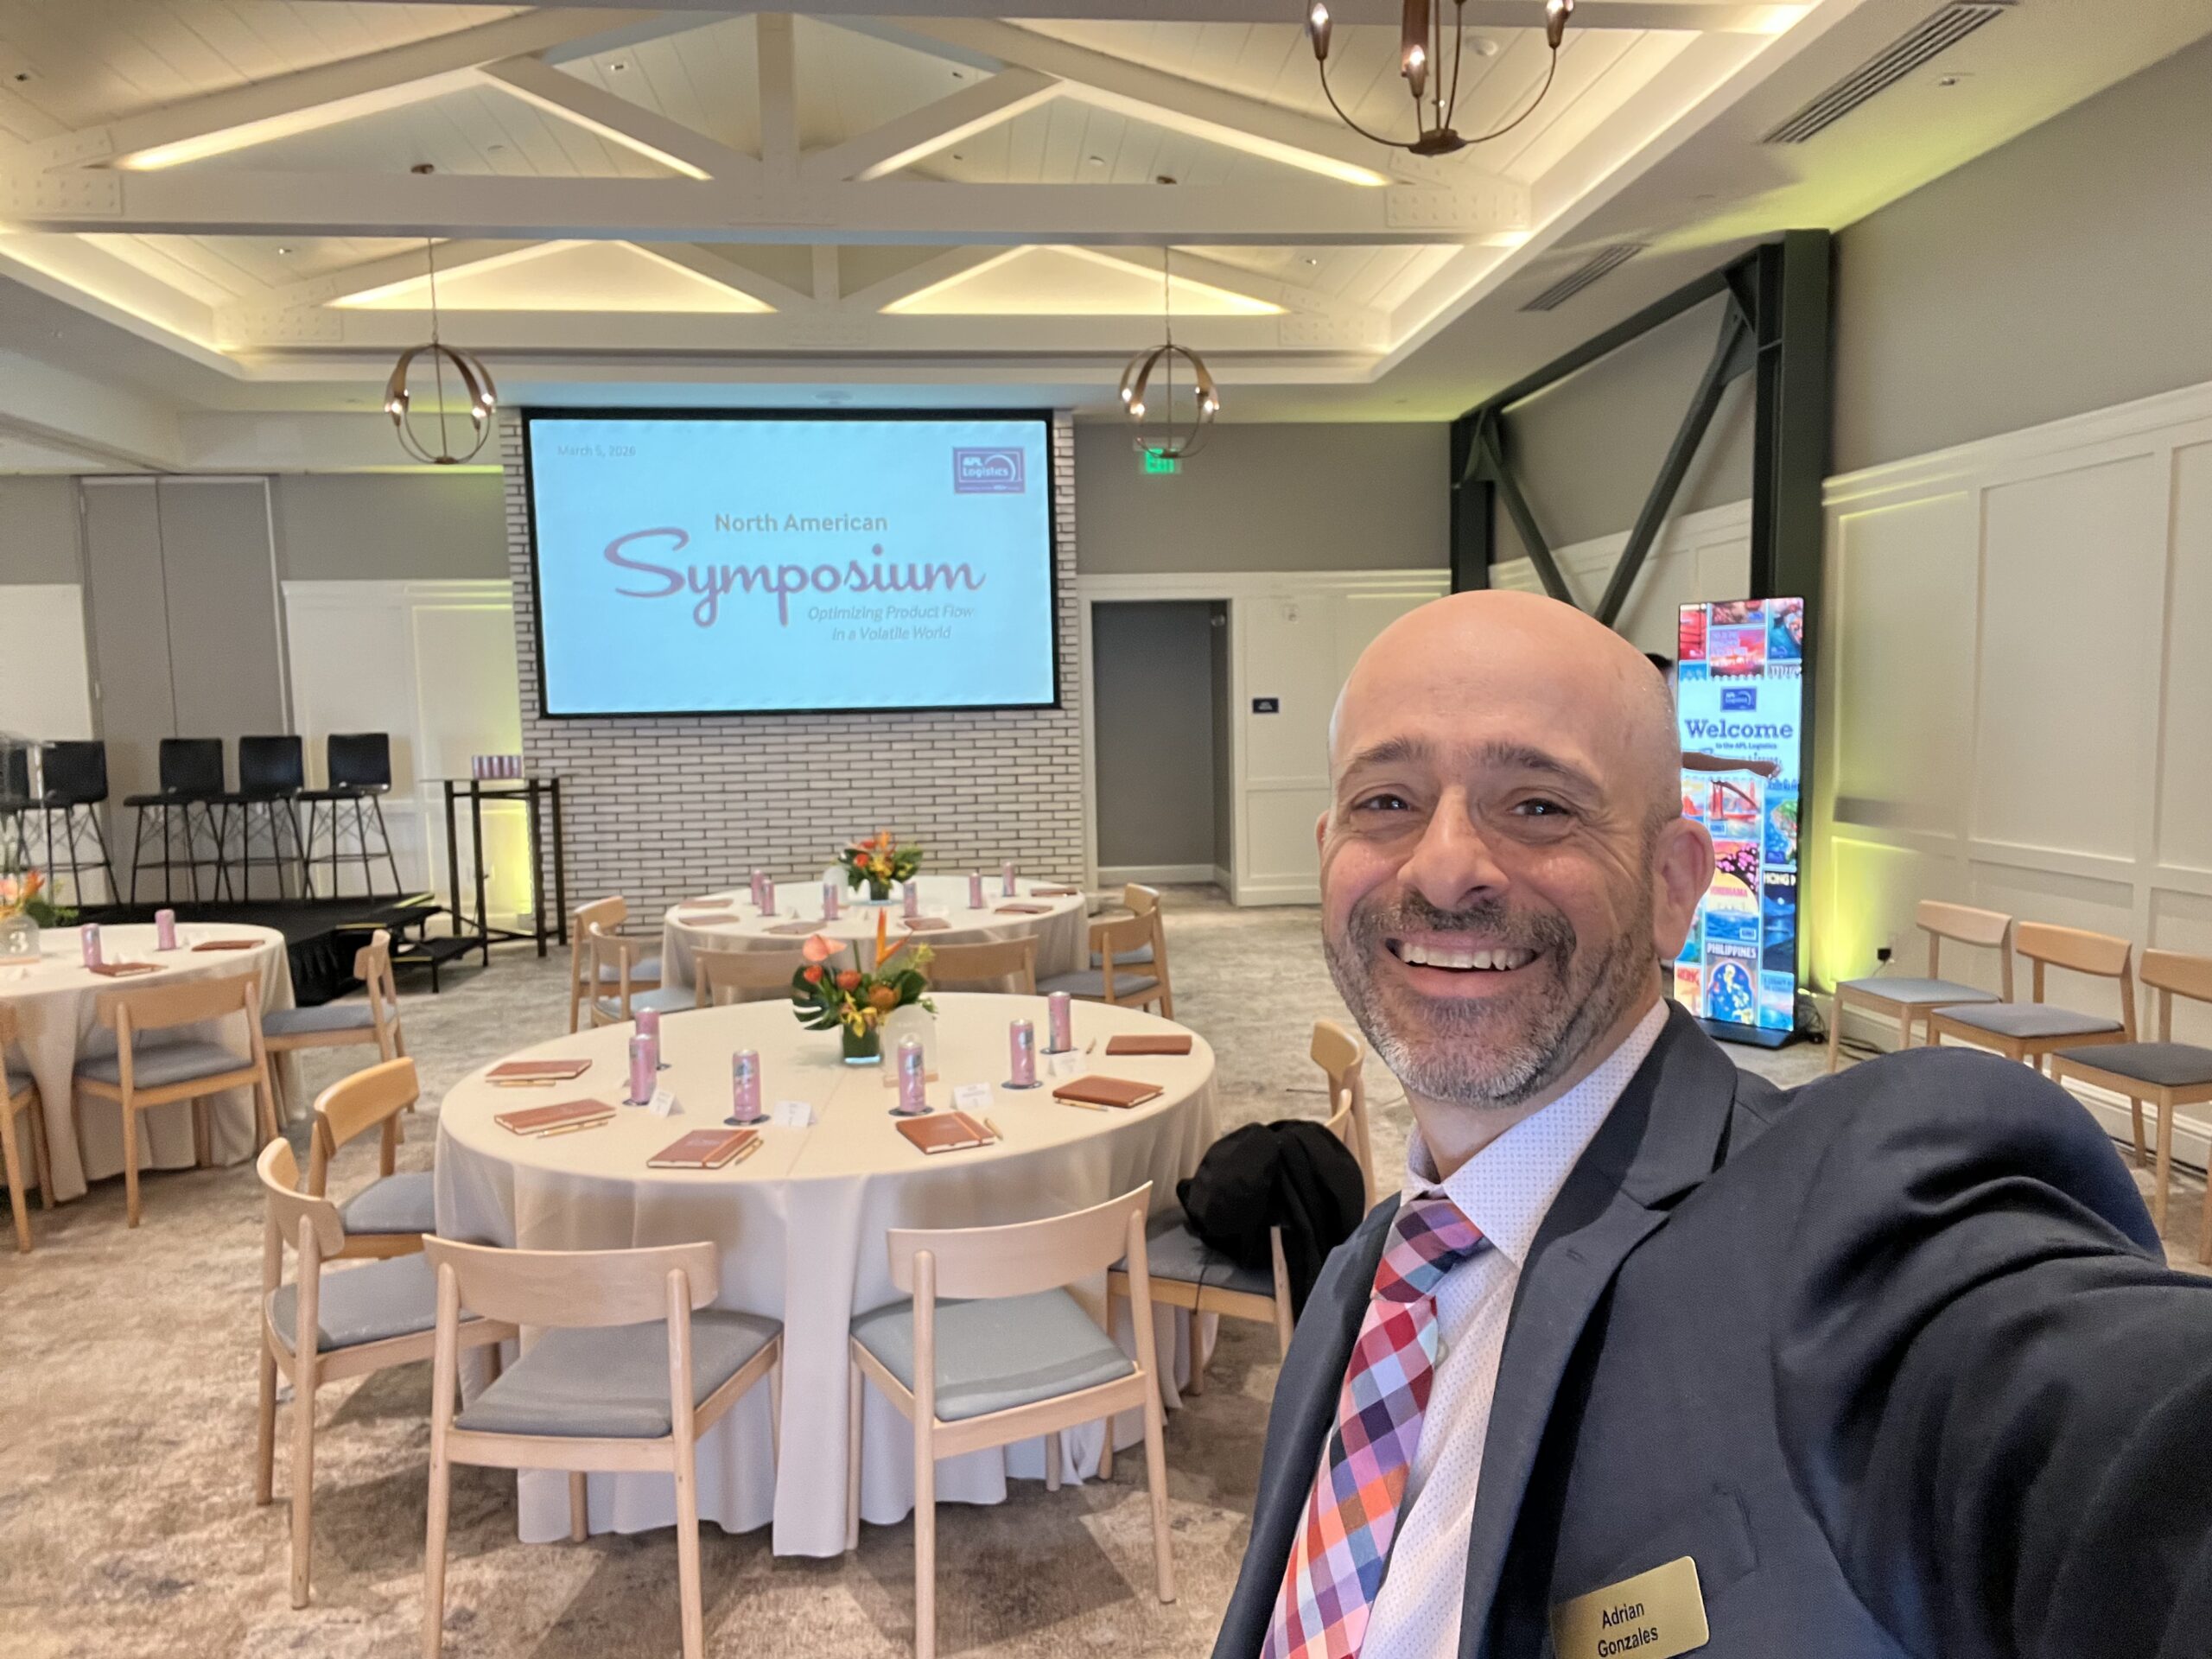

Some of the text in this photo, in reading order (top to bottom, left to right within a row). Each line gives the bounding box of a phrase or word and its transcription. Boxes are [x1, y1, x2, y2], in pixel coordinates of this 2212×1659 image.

[963, 467, 1009, 479] Logistics
[715, 513, 888, 532] North American
[604, 526, 987, 628] Symposium
[807, 604, 975, 622] Optimizing Product Flow
[848, 630, 857, 641] a
[860, 626, 910, 641] Volatile
[912, 626, 952, 640] World
[1684, 718, 1794, 739] Welcome
[10, 931, 29, 954] 3
[1707, 942, 1757, 959] PHILIPPINES
[1601, 1602, 1645, 1630] Adrian
[1597, 1626, 1659, 1658] Gonzales
